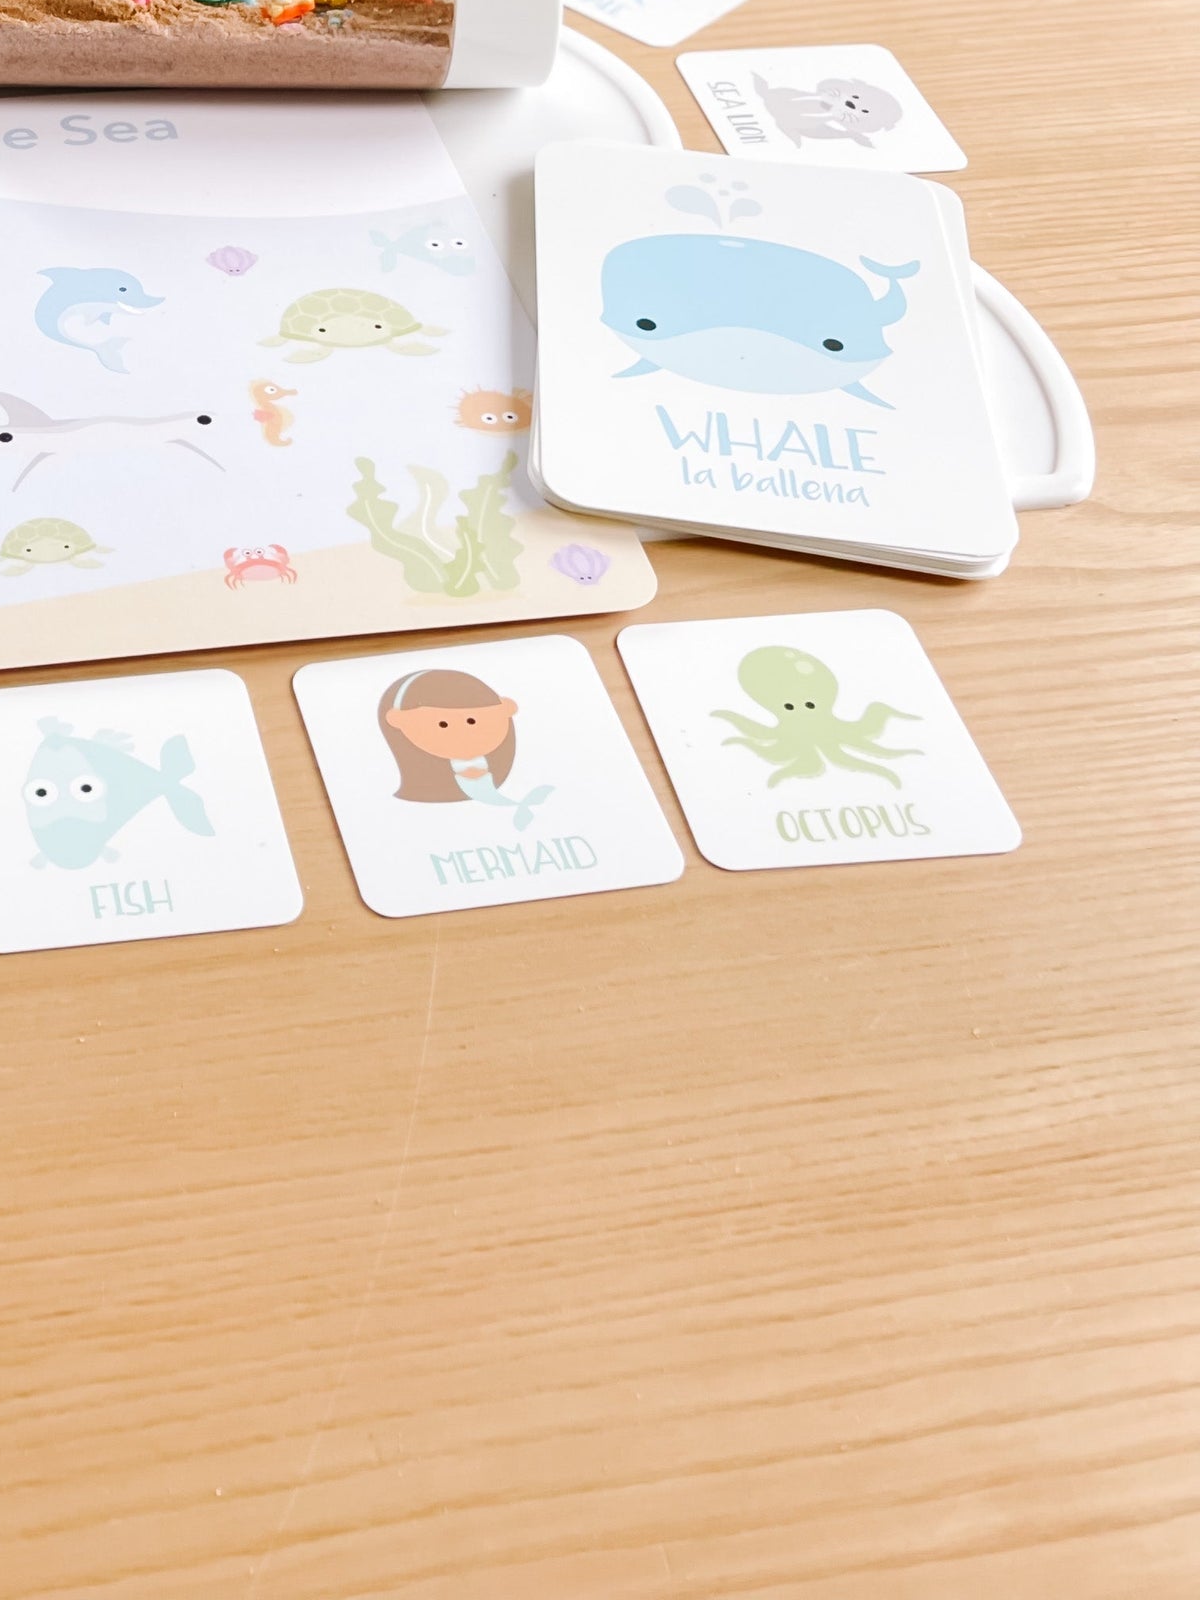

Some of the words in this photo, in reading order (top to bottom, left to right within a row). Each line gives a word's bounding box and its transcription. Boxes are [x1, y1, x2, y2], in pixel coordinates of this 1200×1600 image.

[59, 113, 179, 147] Sea
[706, 81, 747, 110] SEA
[727, 113, 769, 144] LION
[655, 404, 887, 475] WHALE
[681, 456, 718, 489] la
[730, 462, 871, 508] ballena
[775, 803, 932, 843] OCTOPUS
[429, 835, 598, 886] MERMAID
[89, 879, 174, 920] FISH
